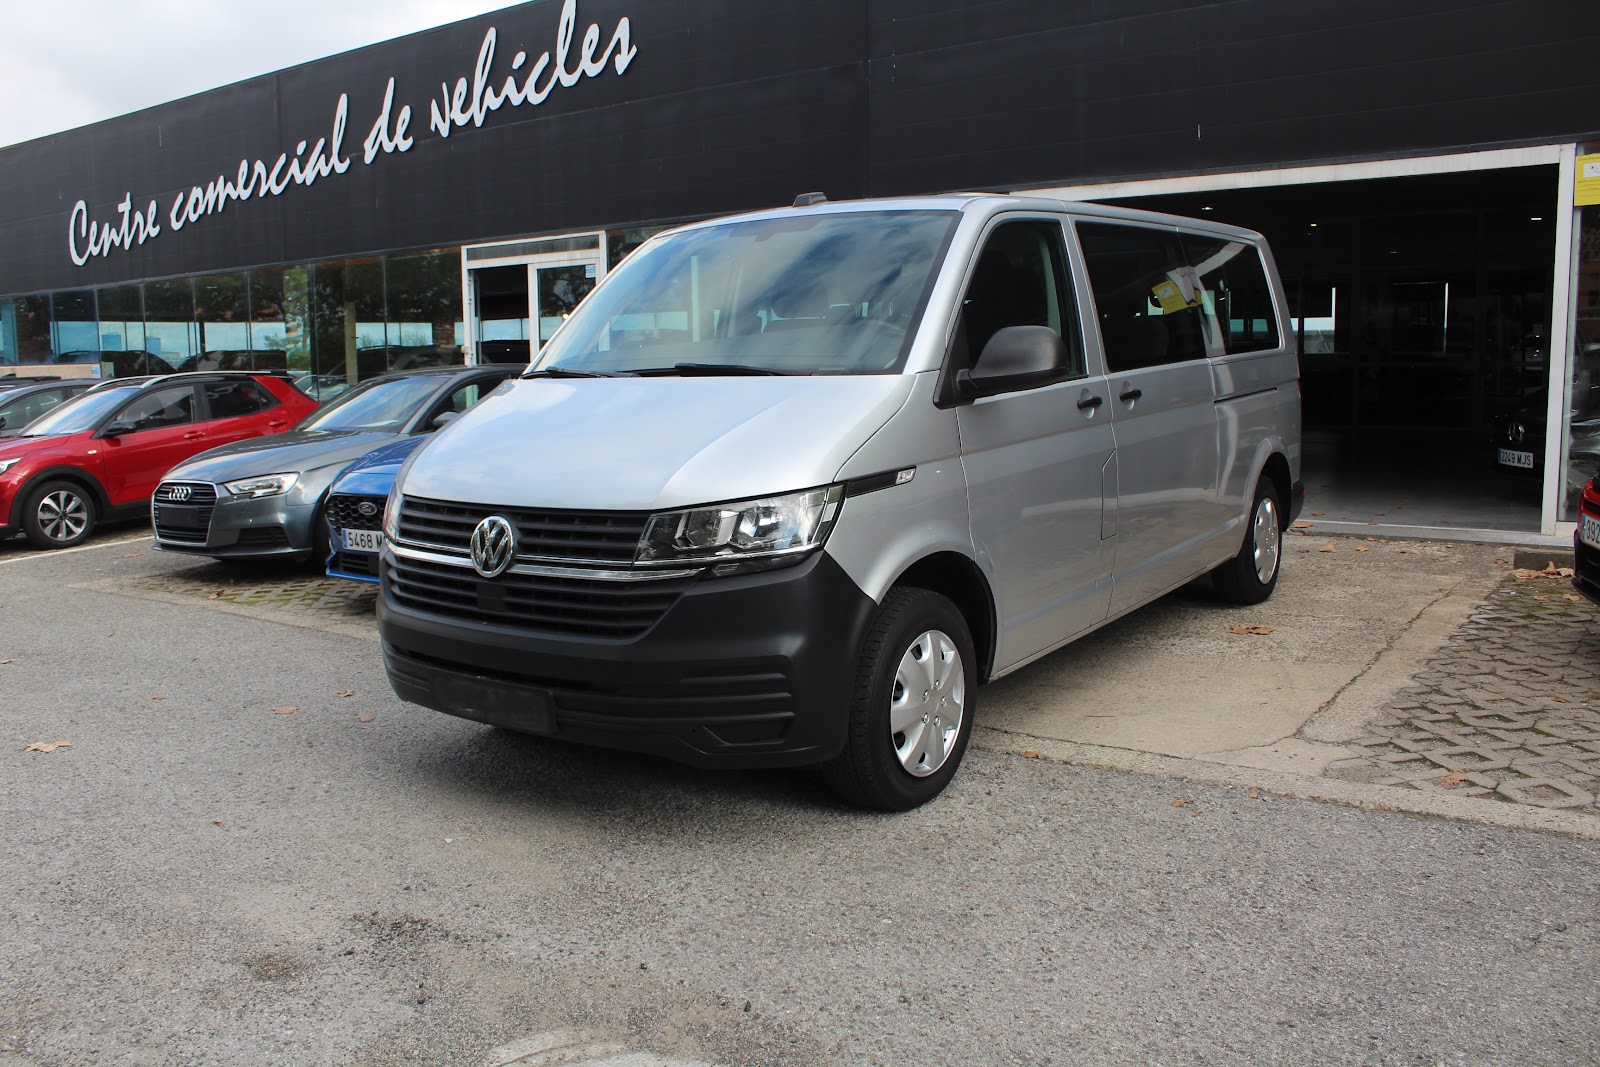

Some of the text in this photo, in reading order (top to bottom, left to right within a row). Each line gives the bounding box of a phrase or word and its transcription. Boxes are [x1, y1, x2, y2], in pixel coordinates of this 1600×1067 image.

[69, 0, 638, 266] Centre comercial de vehicles
[348, 532, 373, 548] 5468
